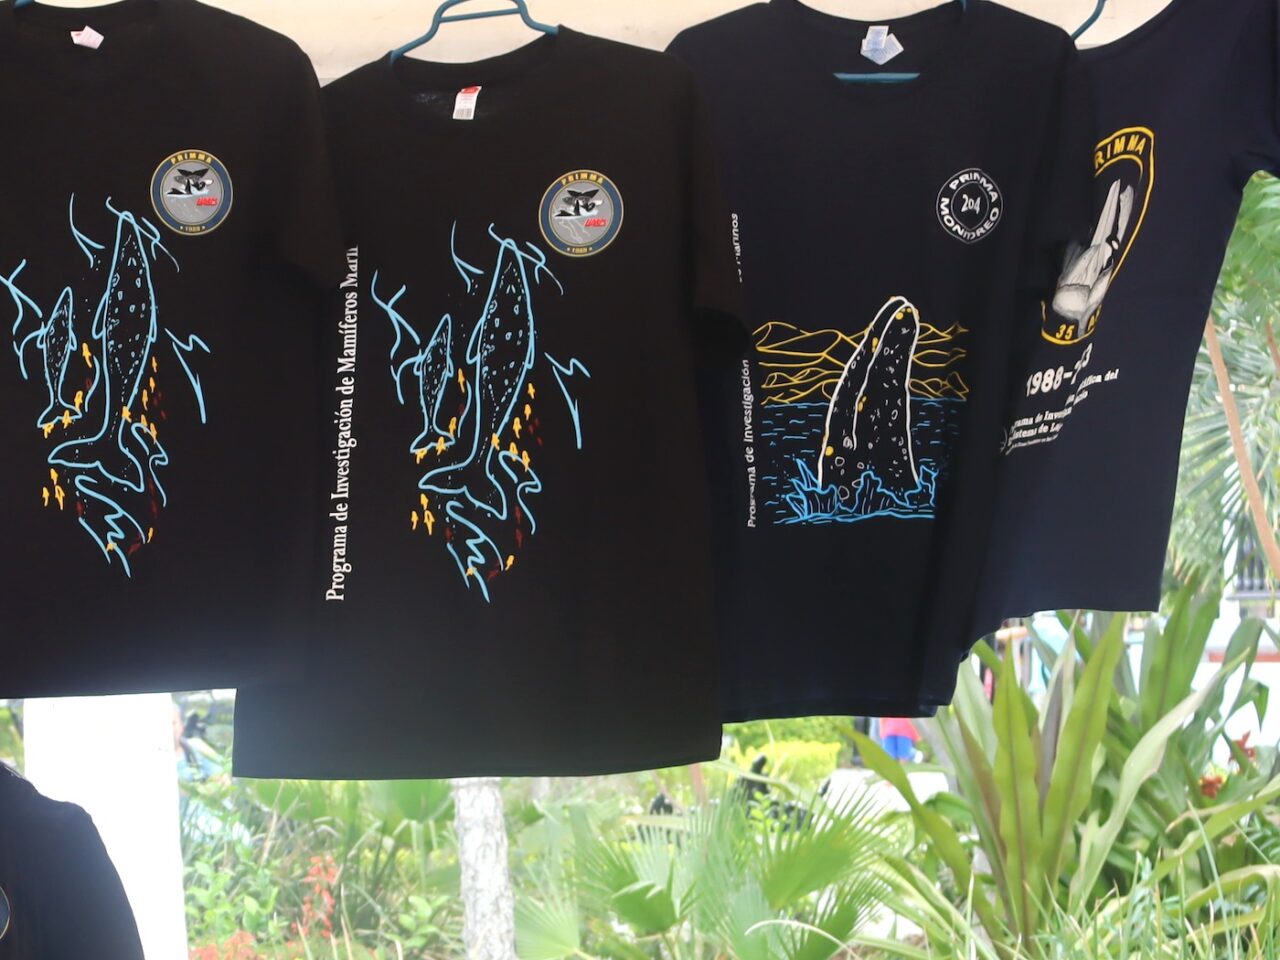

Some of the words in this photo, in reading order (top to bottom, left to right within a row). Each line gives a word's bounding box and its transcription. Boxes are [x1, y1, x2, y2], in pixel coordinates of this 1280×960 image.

[337, 292, 358, 373] Mamíferos
[1056, 324, 1075, 340] 35
[335, 377, 355, 395] de
[331, 399, 357, 500] Investigación
[744, 446, 754, 463] de
[329, 503, 349, 521] de
[326, 526, 352, 600] Programa
